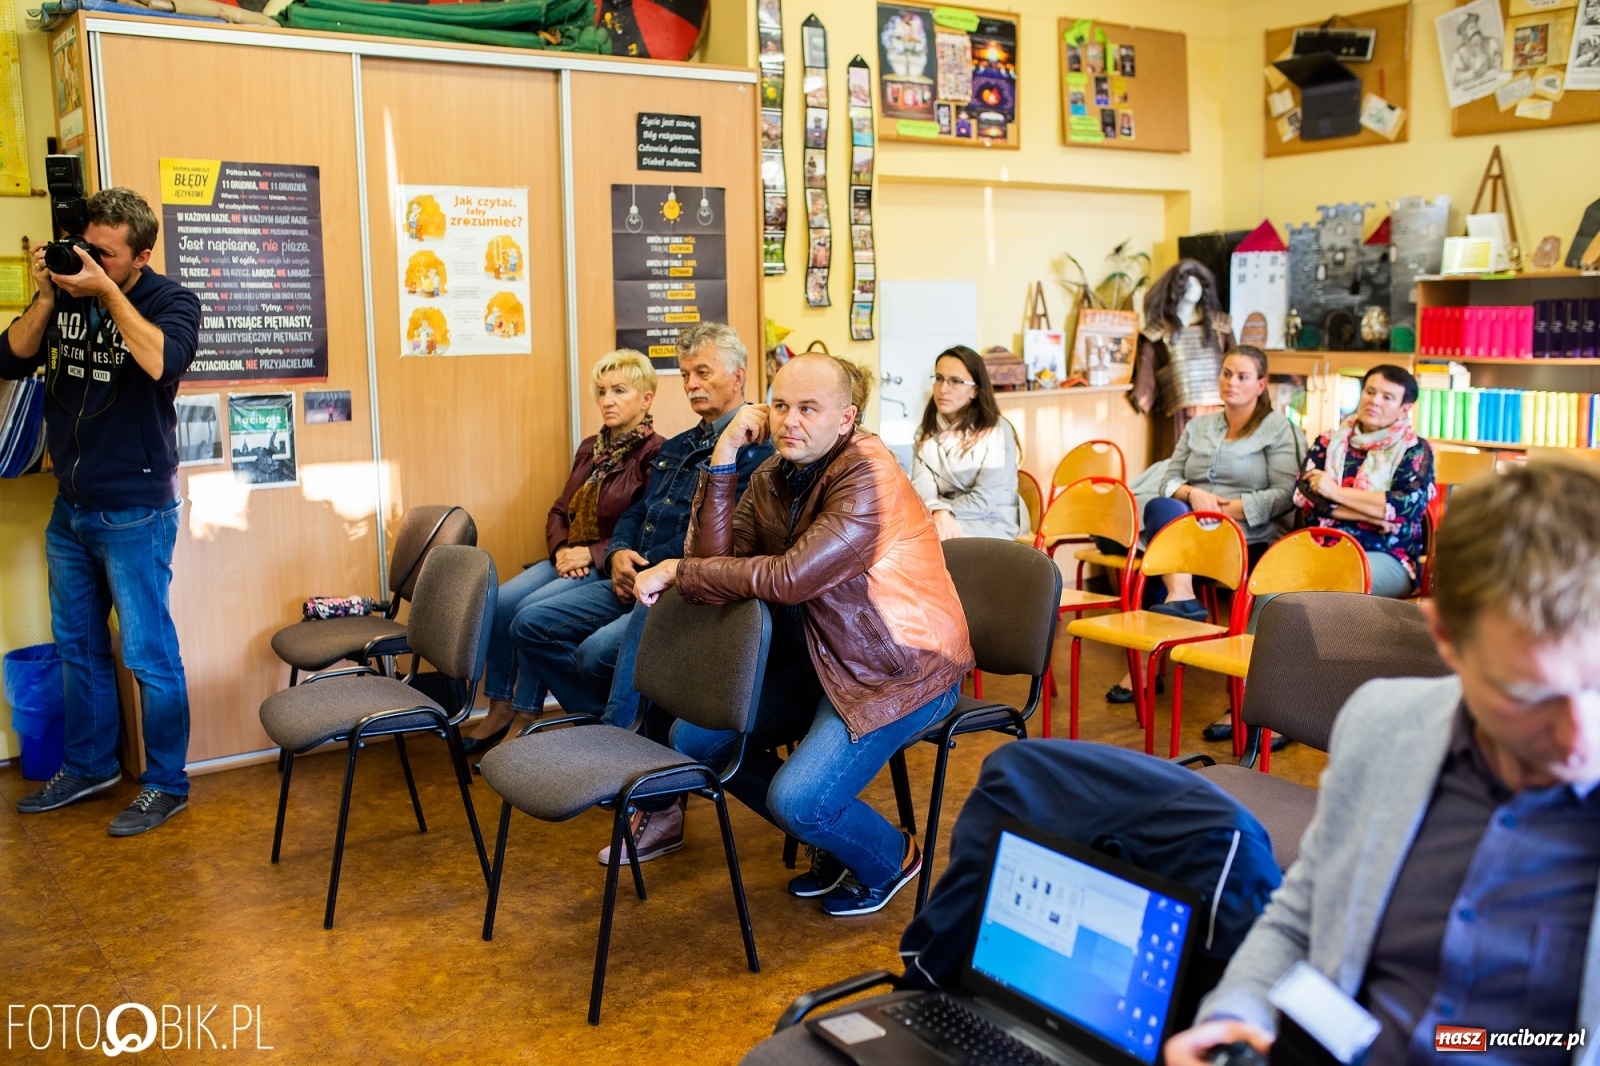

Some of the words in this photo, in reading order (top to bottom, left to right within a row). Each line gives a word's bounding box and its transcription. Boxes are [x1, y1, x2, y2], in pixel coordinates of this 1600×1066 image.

[174, 173, 208, 190] BŁĘDY
[454, 195, 473, 207] Jak
[478, 196, 517, 208] czytać,
[177, 212, 184, 222] W
[184, 211, 210, 222] KAŻDYM
[231, 214, 242, 224] NIE
[249, 214, 274, 224] KAŻDYM
[466, 206, 486, 216] żeby
[450, 215, 523, 228] zrozumieć?
[178, 236, 204, 250] Jest
[208, 238, 260, 256] napisane,
[262, 239, 278, 252] nie
[282, 239, 310, 256] pisze.
[210, 268, 222, 278] NIE
[276, 268, 287, 278] NIE
[260, 303, 282, 312] Tylny,
[204, 316, 226, 329] DWA
[226, 315, 263, 330] TYSIĄCE
[264, 315, 313, 330] PIĘTNASTY,
[198, 332, 214, 344] ROK
[215, 332, 272, 344] DWUTYSIĘCZNY
[273, 331, 314, 344] PIĘTNASTY.
[50, 347, 58, 370] Nikon
[186, 360, 245, 372] RZYJACIOŁOM,
[245, 359, 258, 370] NIE
[260, 358, 316, 370] PRZYJACIELOM.
